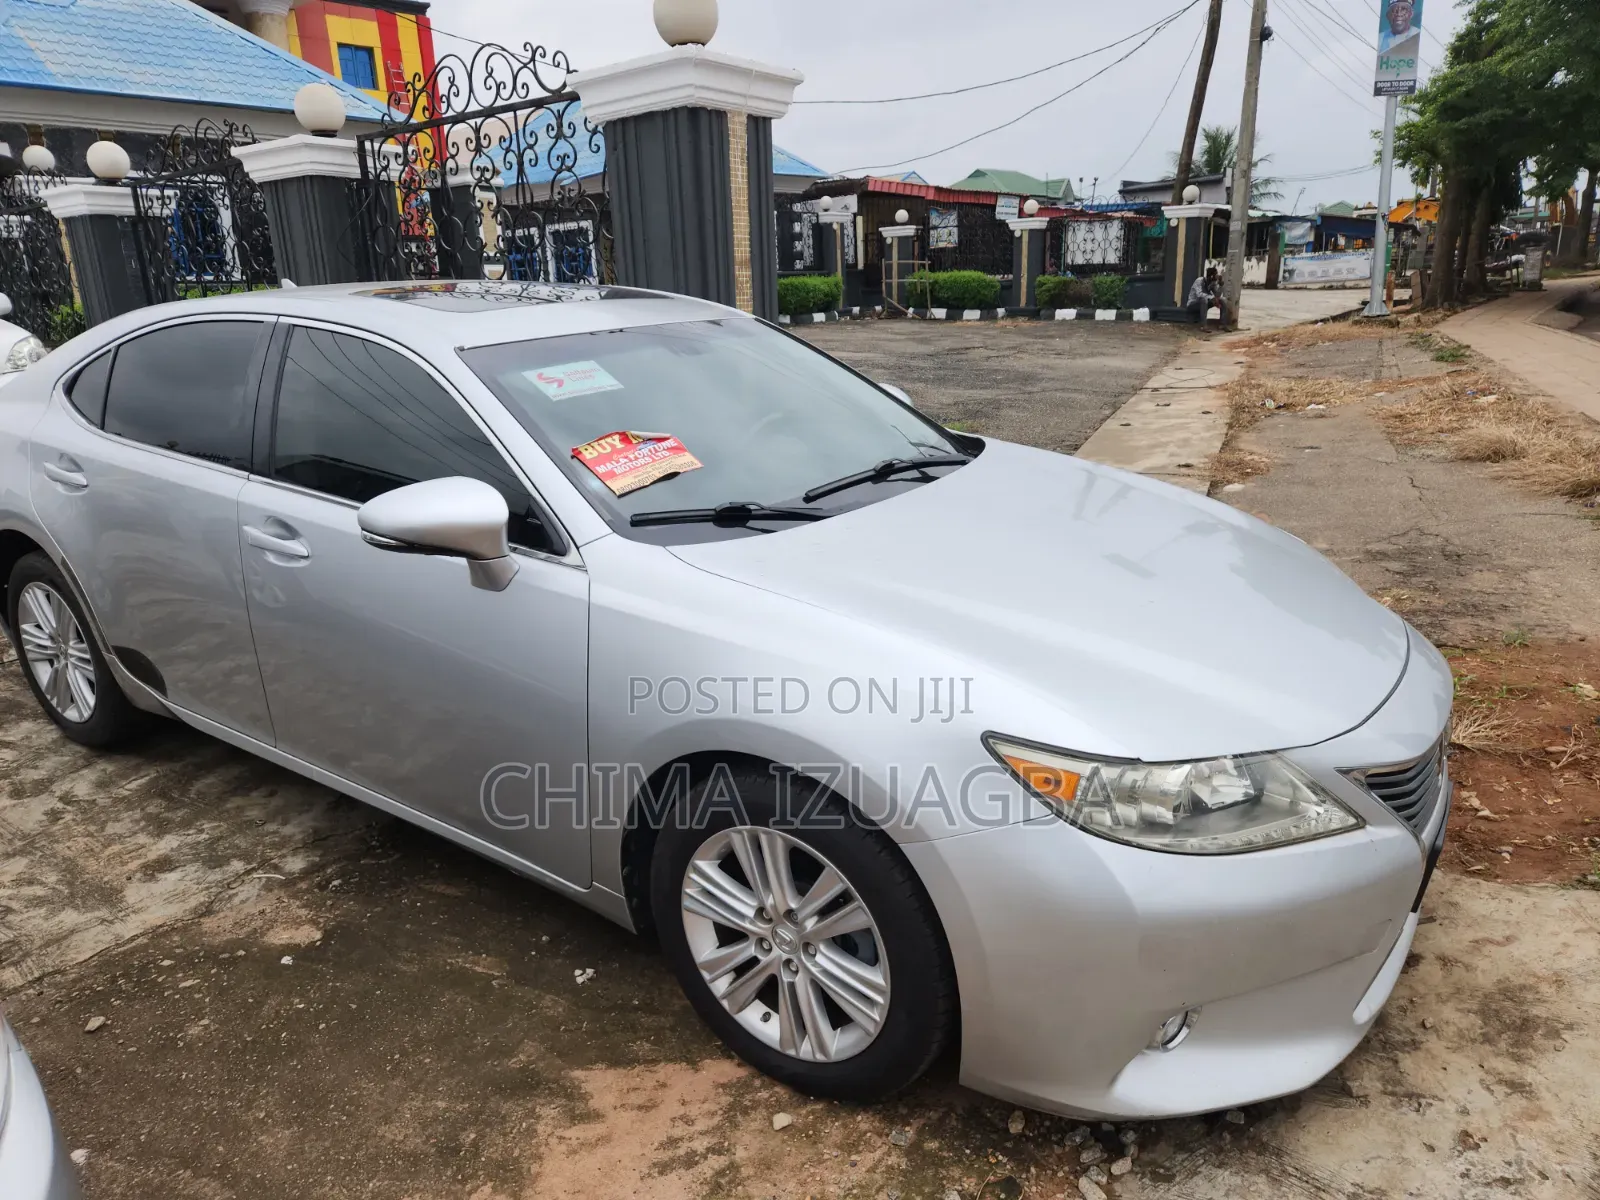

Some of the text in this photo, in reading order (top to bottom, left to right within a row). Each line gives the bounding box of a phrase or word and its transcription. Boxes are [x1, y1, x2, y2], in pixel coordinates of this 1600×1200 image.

[1380, 56, 1415, 76] Hope
[577, 433, 625, 460] BUY
[595, 456, 629, 474] MALA
[629, 438, 678, 461] FORTUNE
[613, 456, 654, 475] MOTORS
